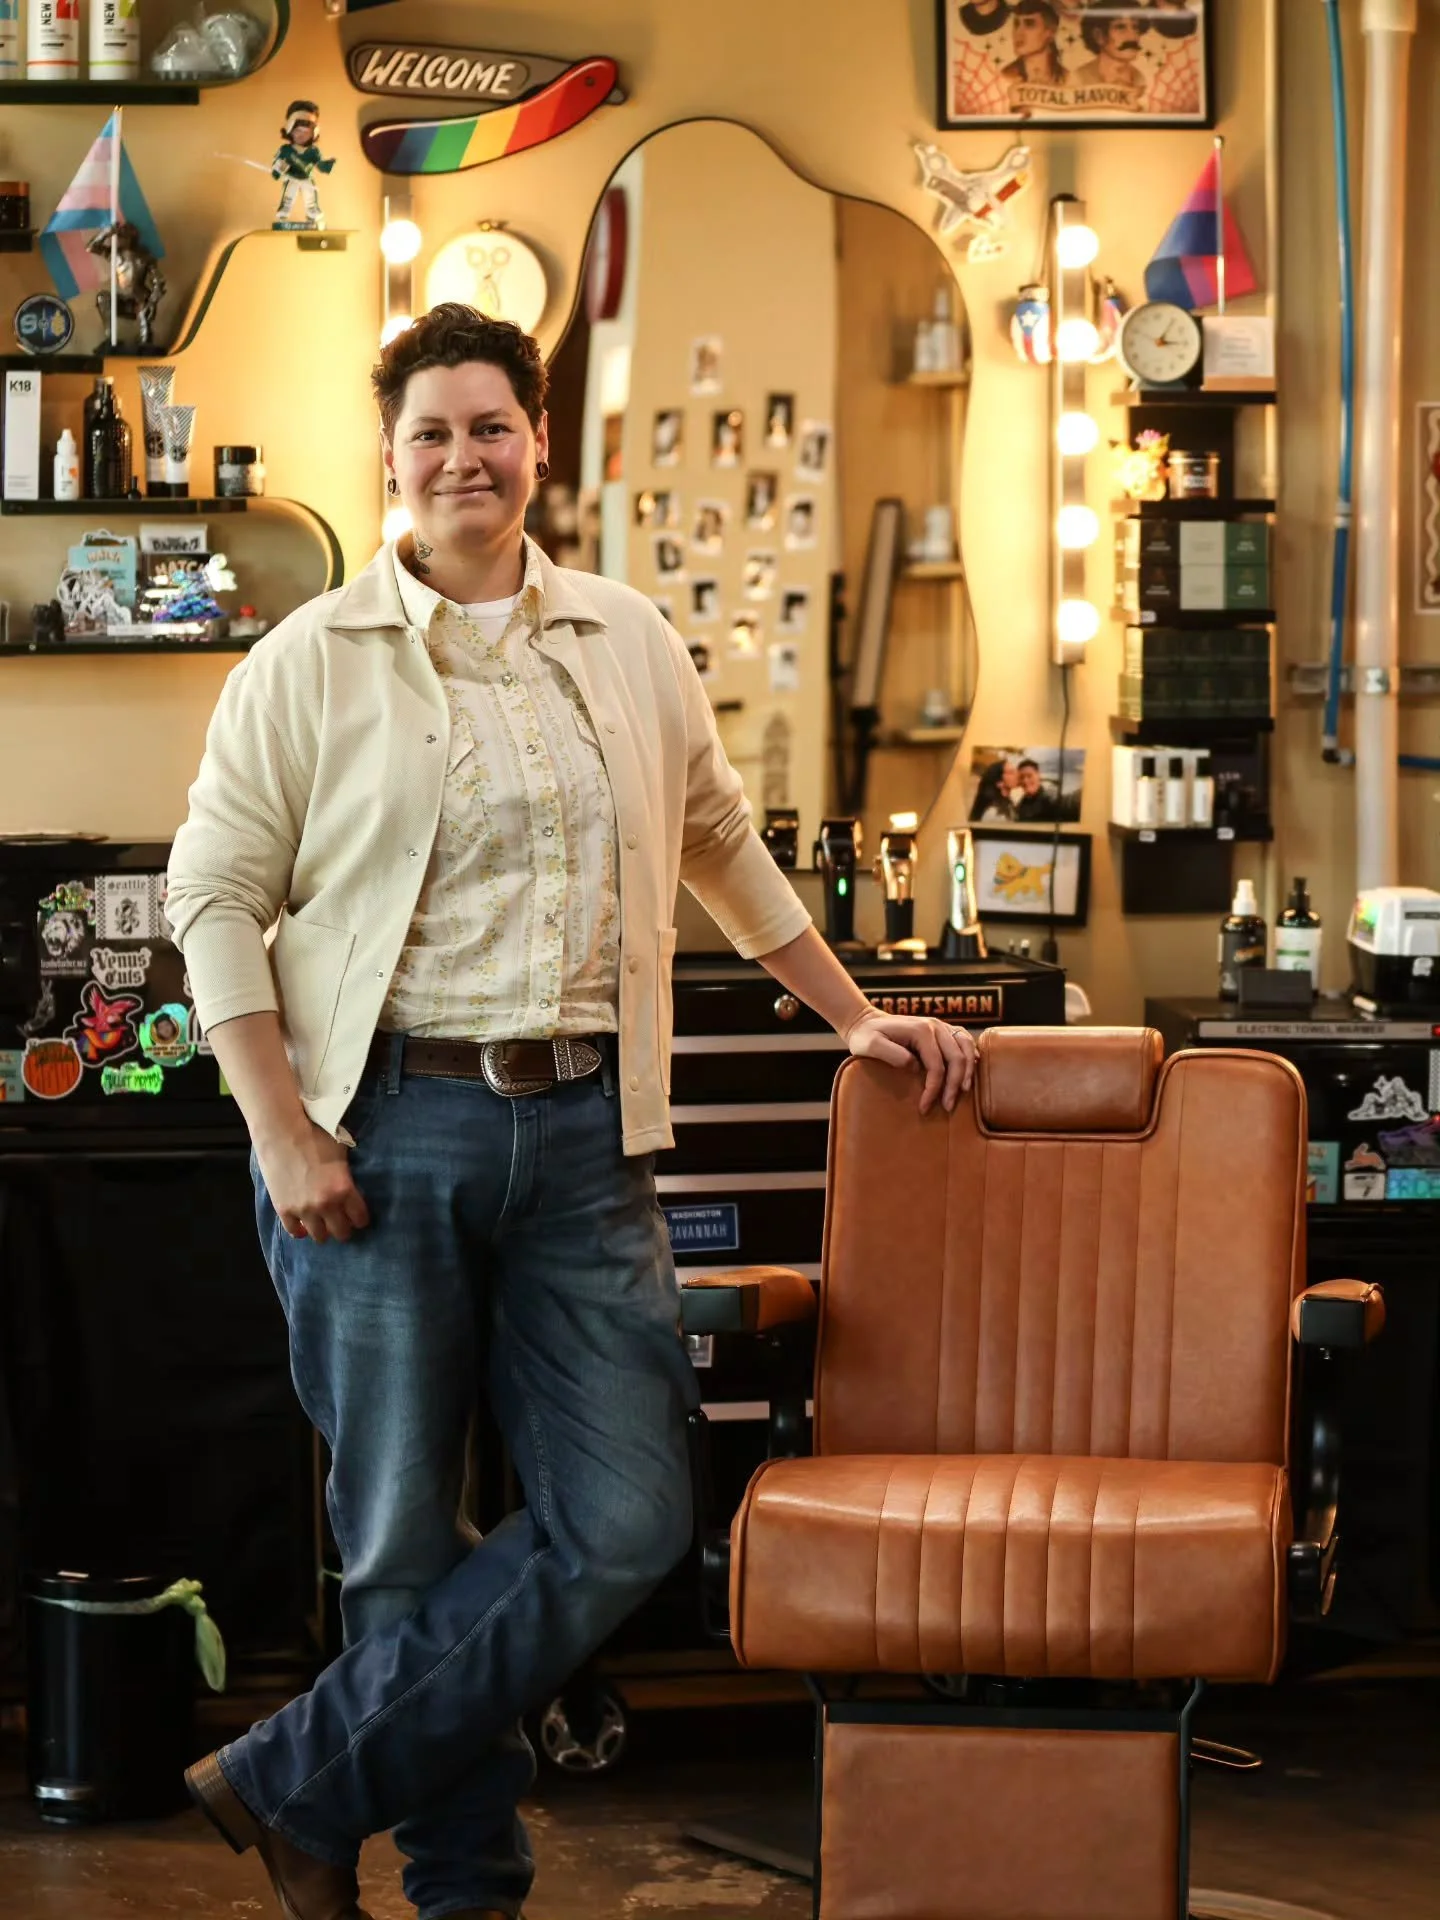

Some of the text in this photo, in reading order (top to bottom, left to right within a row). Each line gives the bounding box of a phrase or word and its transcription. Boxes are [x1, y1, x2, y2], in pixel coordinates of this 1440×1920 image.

[360, 50, 515, 95] WELCOME
[1017, 88, 1131, 105] TOTAL HAVOK
[9, 380, 32, 392] K18
[94, 951, 147, 970] Venus
[1236, 1024, 1385, 1034] ELECTRIC TOWEL WARMER
[671, 1209, 722, 1219] WASHINGTON
